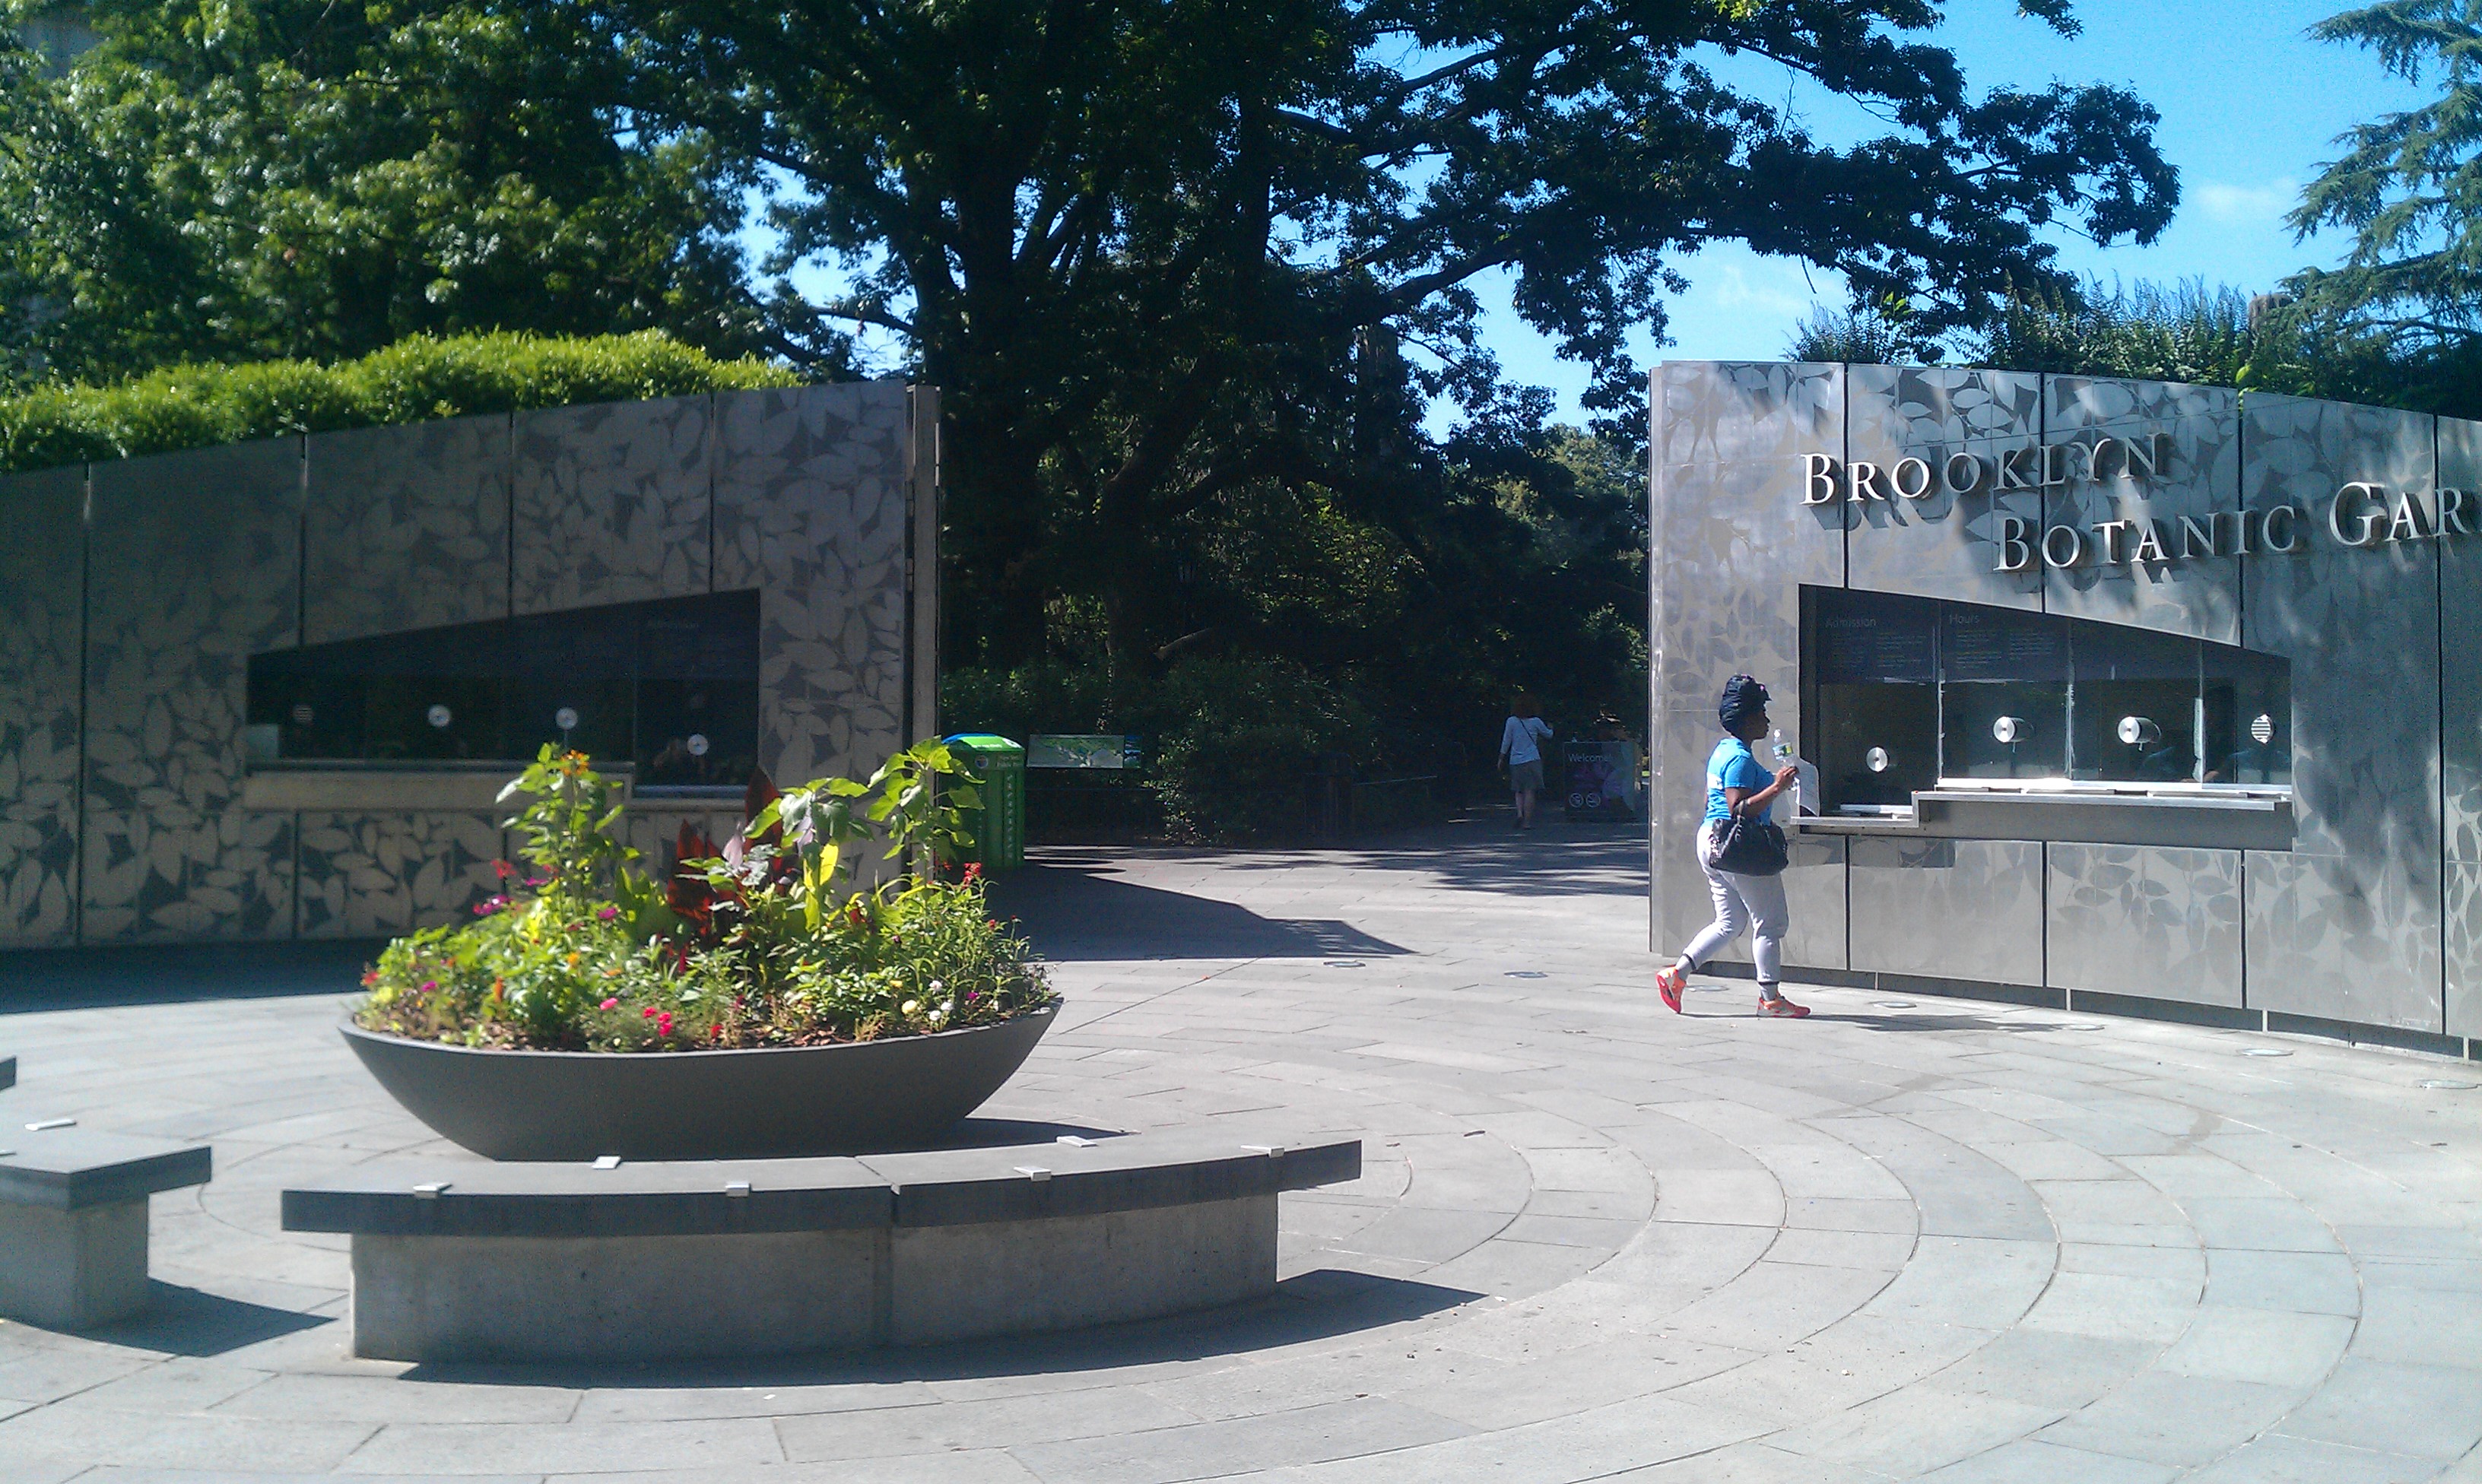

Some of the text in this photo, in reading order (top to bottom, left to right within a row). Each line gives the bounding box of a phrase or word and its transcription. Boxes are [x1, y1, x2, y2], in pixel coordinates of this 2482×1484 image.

[1799, 432, 2170, 506] BROOKLYN
[1992, 481, 2482, 572] BOTANIC GAR
[1825, 617, 1877, 628] Admission
[1949, 614, 1981, 625] Hours
